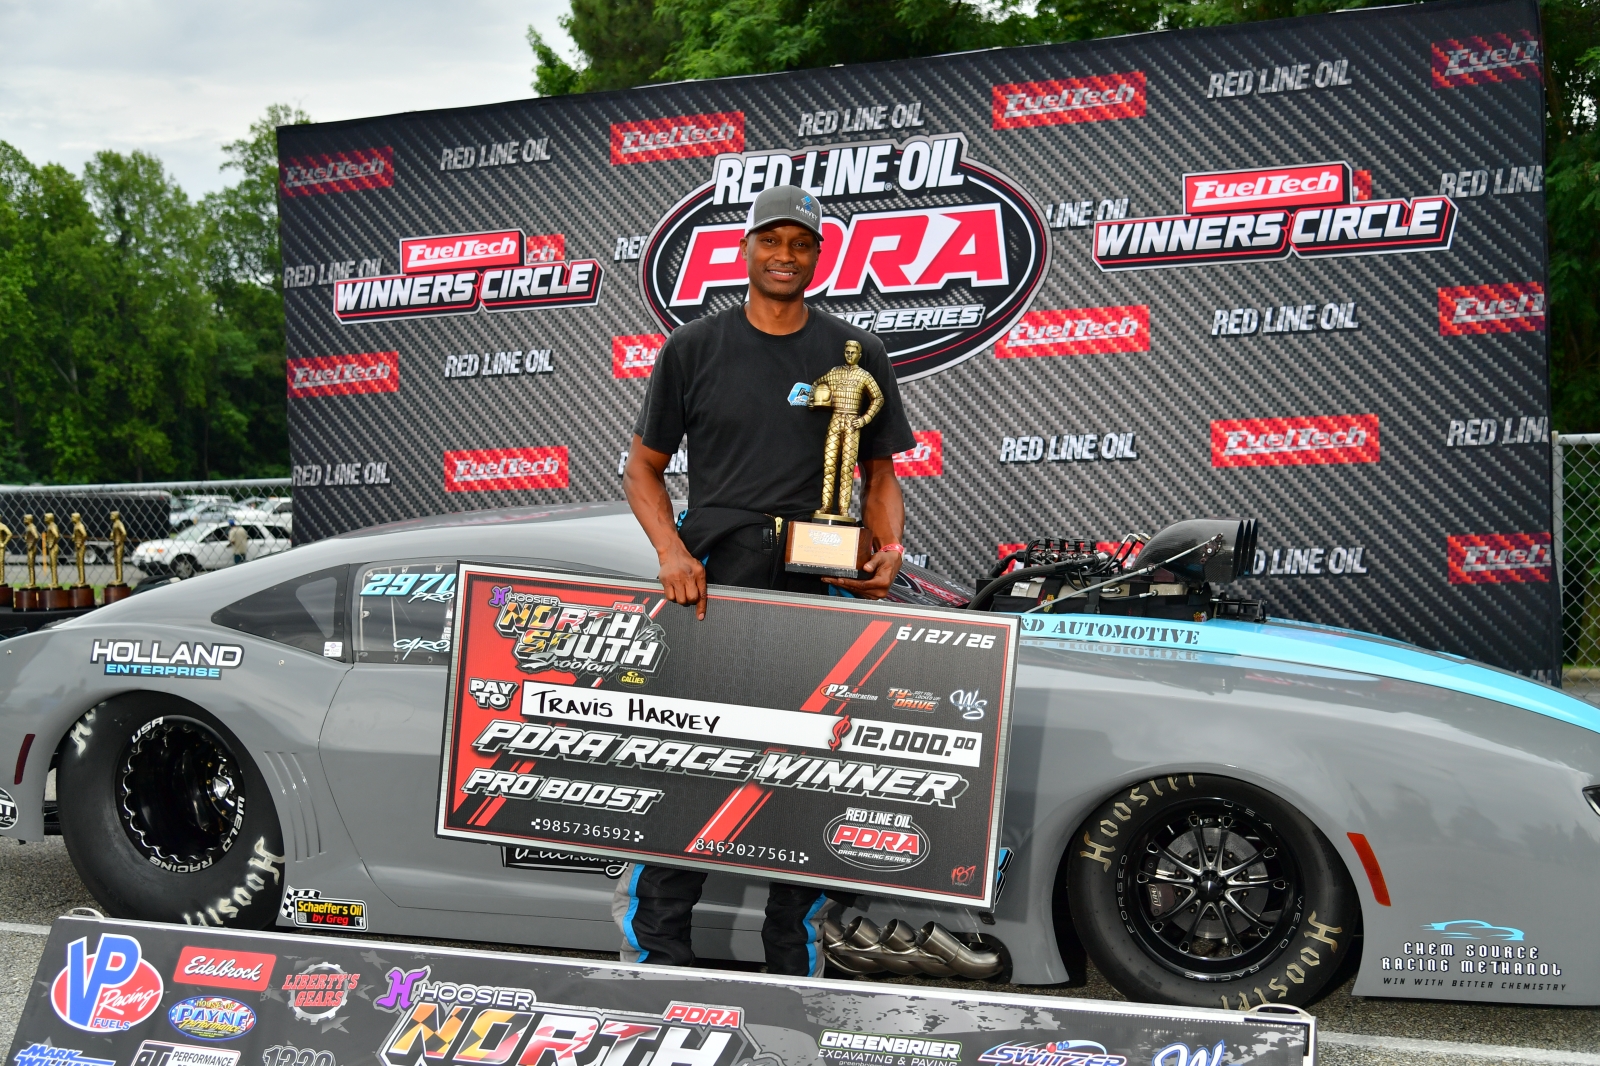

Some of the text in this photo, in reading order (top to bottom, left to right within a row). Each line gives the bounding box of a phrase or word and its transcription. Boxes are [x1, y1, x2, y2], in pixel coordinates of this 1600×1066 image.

[1207, 59, 1352, 98] RED LINE OIL
[1004, 83, 1135, 118] FuelTech
[799, 102, 924, 136] RED LINE OIL
[622, 122, 734, 154] FuelTech
[440, 138, 550, 171] RED LINE OIL
[285, 157, 385, 188] FuelTech
[712, 138, 964, 205] RED LINE OIL
[1439, 170, 1488, 197] RED
[1192, 171, 1339, 207] FuelTech
[795, 204, 818, 221] HARVEY
[1049, 201, 1093, 227] LINE
[1097, 200, 1443, 256] WINNERS CIRCLE
[407, 236, 517, 268] FuelTech
[284, 263, 315, 288] RED
[317, 260, 355, 281] LINE
[337, 263, 593, 312] WINNERS CIRCLE
[875, 306, 982, 331] SERIES
[1211, 302, 1358, 335] RED LINE OIL
[1007, 317, 1138, 347] FuelTech
[293, 362, 390, 388] FuelTech
[445, 350, 553, 378] RED LINE OIL
[1224, 427, 1367, 456] FuelTech
[1447, 419, 1497, 446] RED
[1000, 432, 1137, 462] RED LINE OIL
[293, 462, 391, 486] RED LINE OIL
[454, 456, 559, 482] FuelTech
[1270, 548, 1325, 575] LINE
[1328, 546, 1367, 574] OIL
[509, 593, 560, 606] HOOSIER
[614, 604, 645, 614] PDRA
[500, 602, 642, 639] NORTH
[1051, 620, 1200, 645] AUTOMOTIVE
[393, 636, 451, 661] CARO
[519, 629, 659, 667] SOUTH
[896, 626, 996, 650] 6/27/26
[92, 641, 242, 667] HOLLAND
[521, 652, 620, 674] Shootout
[105, 663, 220, 679] ENTERPRISE
[621, 676, 645, 685] CALLIES
[470, 679, 515, 696] PAY
[476, 692, 508, 707] TO
[825, 683, 849, 698] P2
[628, 698, 721, 734] HARVEY
[894, 699, 936, 711] DRIVE
[131, 716, 164, 744] USA
[477, 721, 961, 802] PDRA RACE WINNER
[465, 770, 657, 810] PRO BOOST
[222, 795, 245, 853] WELD
[542, 818, 631, 841] 985736592
[846, 809, 911, 829] RED LINE OIL
[695, 838, 798, 863] 8462027561
[831, 825, 920, 856] PDRA
[149, 855, 213, 873] RACING
[838, 849, 913, 864] DRAG RACING SERIES
[1115, 854, 1136, 934] FORGED
[312, 912, 349, 926] by Greg
[349, 904, 363, 916] Oil
[1279, 895, 1304, 950] WELD
[1403, 941, 1539, 960] CHEM SOURCE
[66, 932, 143, 1028] VP
[184, 955, 261, 982] Edelbrock
[1184, 964, 1260, 982] RACING
[1381, 957, 1562, 977] RACING METHANOL
[282, 973, 360, 990] LIBERTY'S
[1383, 977, 1567, 991] WIN WITH BETTER CHEMISTRY
[97, 984, 162, 1017] Racing
[196, 1000, 224, 1009] HOUSE
[294, 991, 344, 1008] GEARS
[420, 984, 533, 1008] HOOSIER
[93, 1018, 131, 1032] FUELS
[175, 1005, 250, 1030] PAYNE
[179, 1019, 241, 1033] Performance
[664, 1005, 740, 1029] PDRA
[391, 1002, 731, 1066] NORTH
[820, 1031, 961, 1059] GREENBRIER
[20, 1045, 83, 1060] MARK
[172, 1051, 234, 1066] PERFORMANCE
[818, 1049, 894, 1064] EXCAVATING
[897, 1057, 906, 1065] &
